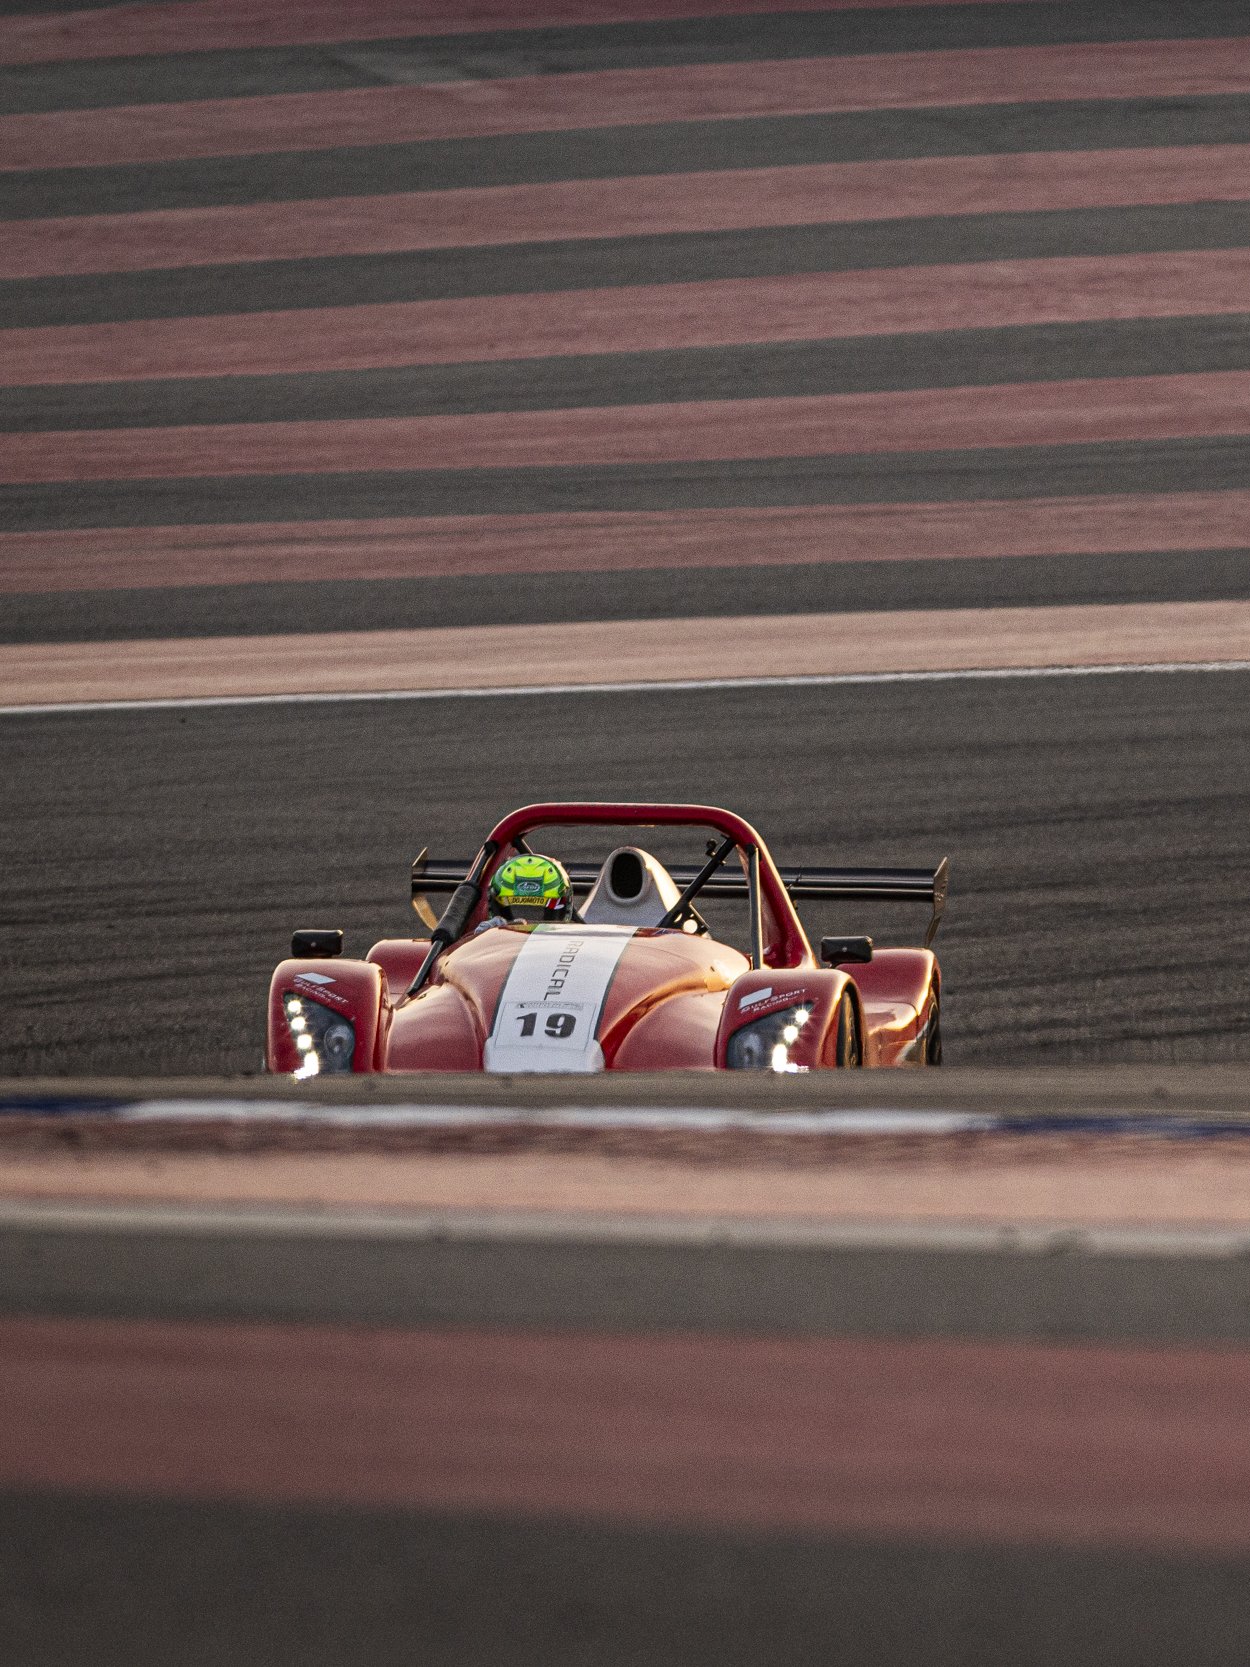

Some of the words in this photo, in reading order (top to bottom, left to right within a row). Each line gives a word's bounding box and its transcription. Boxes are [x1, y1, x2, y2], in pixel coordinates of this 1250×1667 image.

[544, 940, 584, 1001] RADICAL
[741, 988, 806, 1014] GULFSPORT
[516, 1012, 577, 1038] 19
